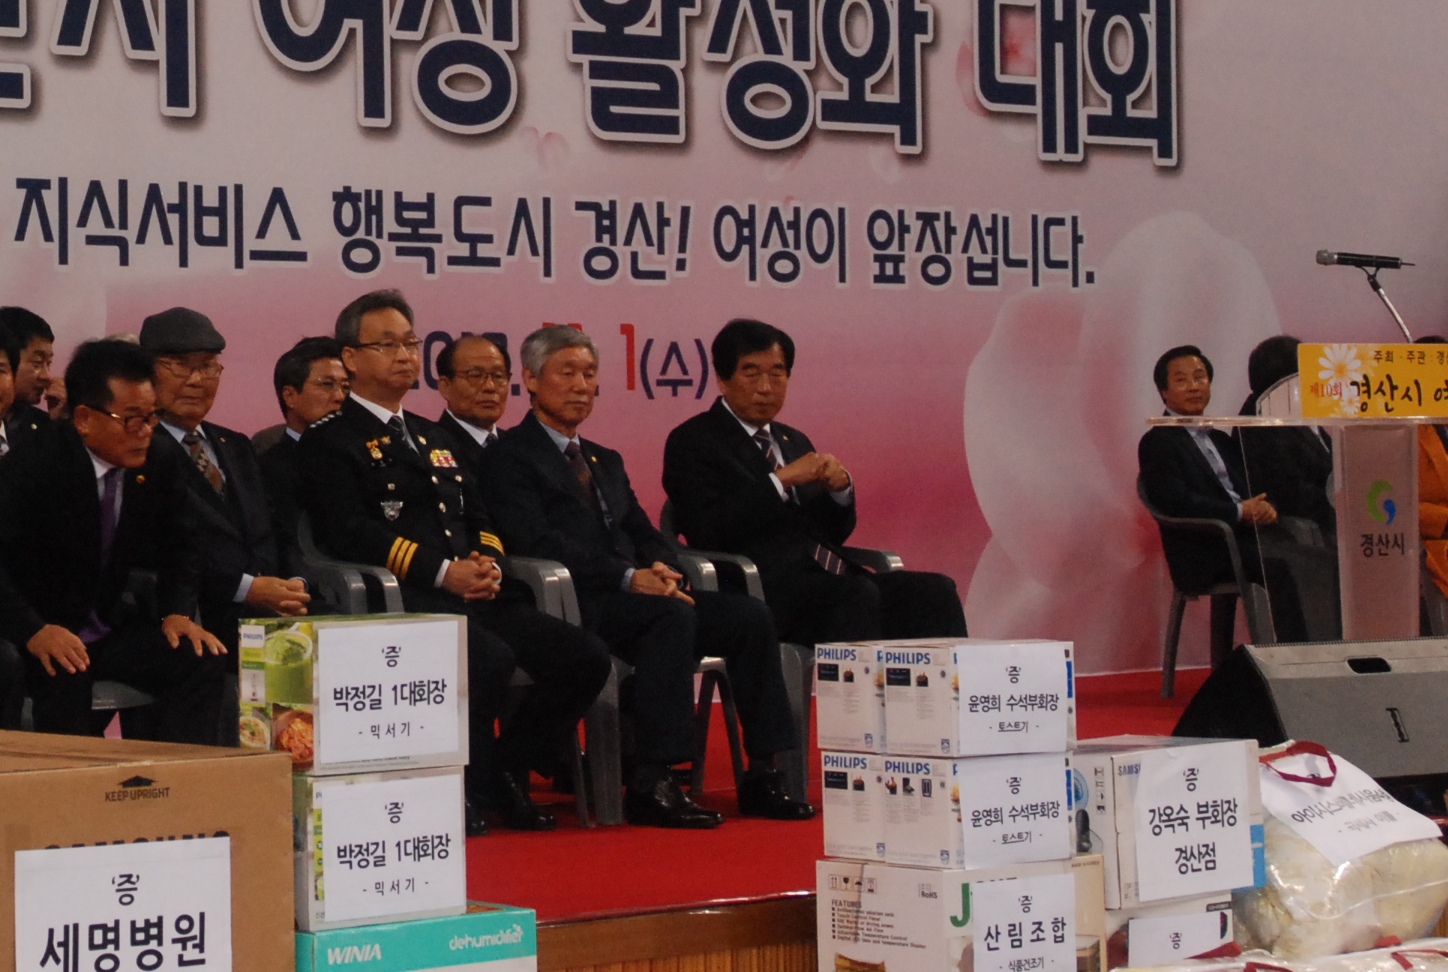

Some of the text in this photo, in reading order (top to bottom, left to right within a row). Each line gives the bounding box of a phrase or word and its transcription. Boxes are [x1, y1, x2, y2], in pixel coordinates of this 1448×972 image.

[14, 176, 308, 270] 지식서비스
[331, 186, 552, 278] 행복도시
[574, 200, 691, 280] 경산!
[712, 203, 847, 284] 여성이
[867, 208, 1096, 288] 앞장섭니다.
[1374, 350, 1394, 363] 주최
[1310, 382, 1342, 398] 제10회
[1350, 374, 1421, 413] 경산시
[1359, 532, 1405, 557] 경산시
[817, 648, 856, 661] PHILIPS
[885, 652, 931, 665] PHILIPS
[334, 678, 447, 712] 박정길 1대회장
[968, 693, 1060, 713] 윤영희 수석부회장
[998, 721, 1028, 733] 토스트기
[824, 755, 867, 769] PHILIPS
[885, 760, 931, 775] PHILIPS
[104, 787, 170, 802] KEEP UPRIGHT
[970, 800, 1060, 828] 윤영희 수석부회장
[1148, 798, 1238, 836] 강옥숙 부회장
[1001, 831, 1032, 844] 토스트기
[337, 833, 451, 870] 박정길 1대회장
[1174, 842, 1217, 875] 경산점
[39, 912, 206, 972] 세명병원
[449, 924, 524, 950] dehumidifier
[327, 943, 382, 965] WINIA
